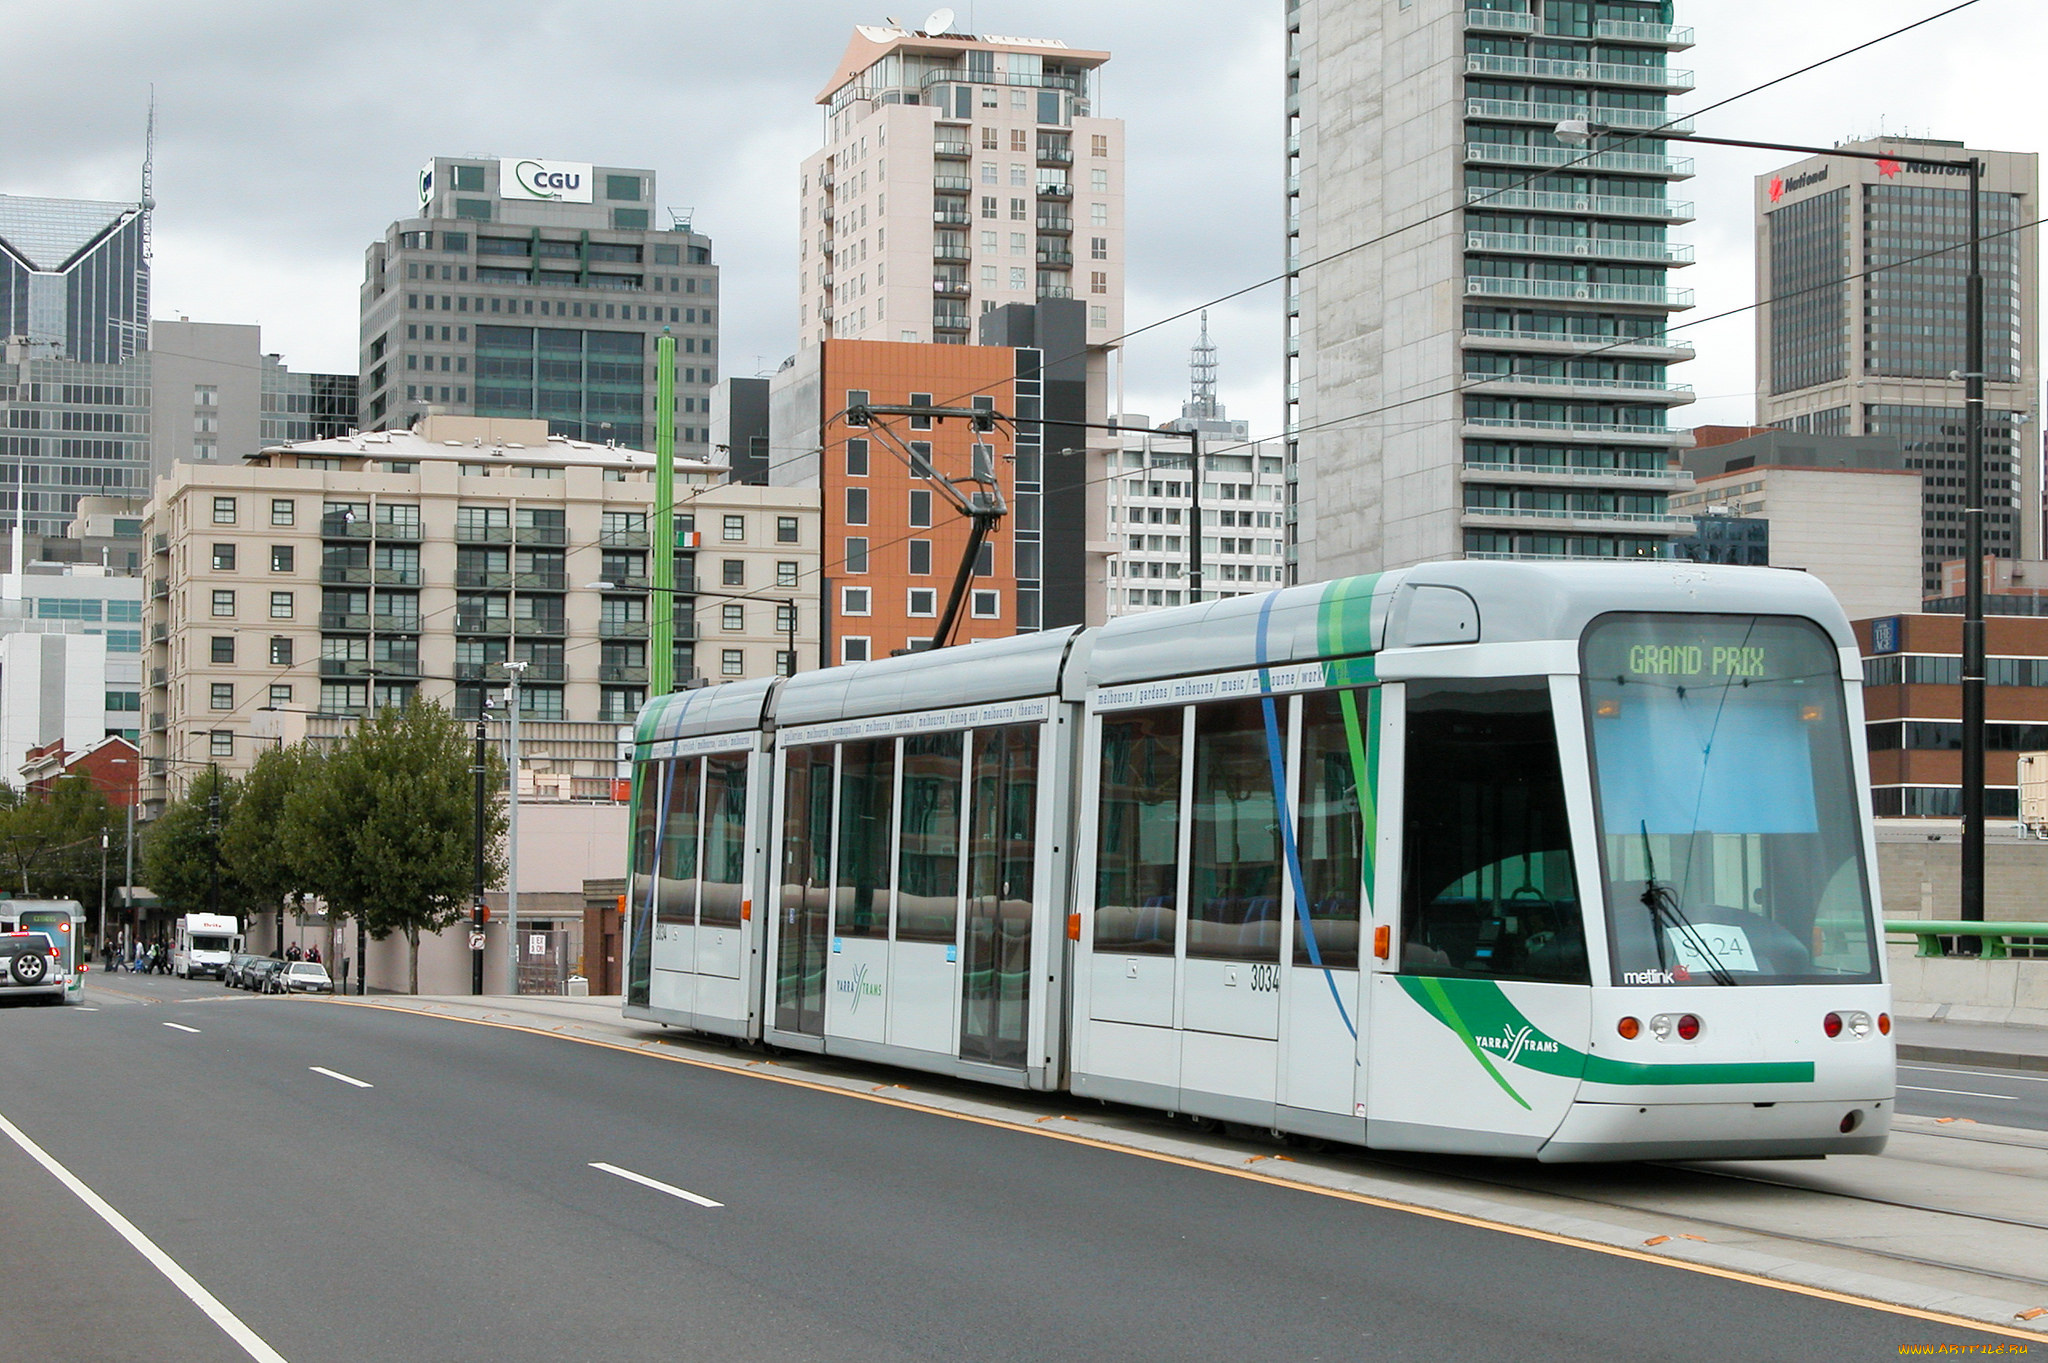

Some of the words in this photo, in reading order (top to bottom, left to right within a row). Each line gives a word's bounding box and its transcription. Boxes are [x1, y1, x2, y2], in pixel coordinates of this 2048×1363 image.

[1785, 164, 1828, 193] National
[1905, 161, 1985, 177] Nationl
[534, 172, 580, 190] CGU
[1875, 628, 1891, 641] THE
[1630, 645, 1702, 674] GRAND
[1712, 646, 1765, 676] PRIX
[1098, 690, 1133, 705] melbourne
[1140, 685, 1167, 704] gardens
[1175, 681, 1213, 696] melbourne
[1222, 677, 1244, 691] music
[1252, 671, 1294, 688] mourne
[1302, 665, 1322, 682] work
[919, 714, 945, 727] melbourne
[950, 711, 967, 725] dining
[983, 706, 1013, 720] melbourne
[1018, 703, 1043, 716] theatres
[1682, 937, 1744, 957] S24
[1251, 964, 1279, 992] 3034
[1624, 969, 1675, 984] metlink
[837, 980, 854, 992] YARRA
[863, 983, 881, 996] TRAMS
[1475, 1036, 1509, 1049] YARRA
[1524, 1040, 1559, 1053] TRAMS
